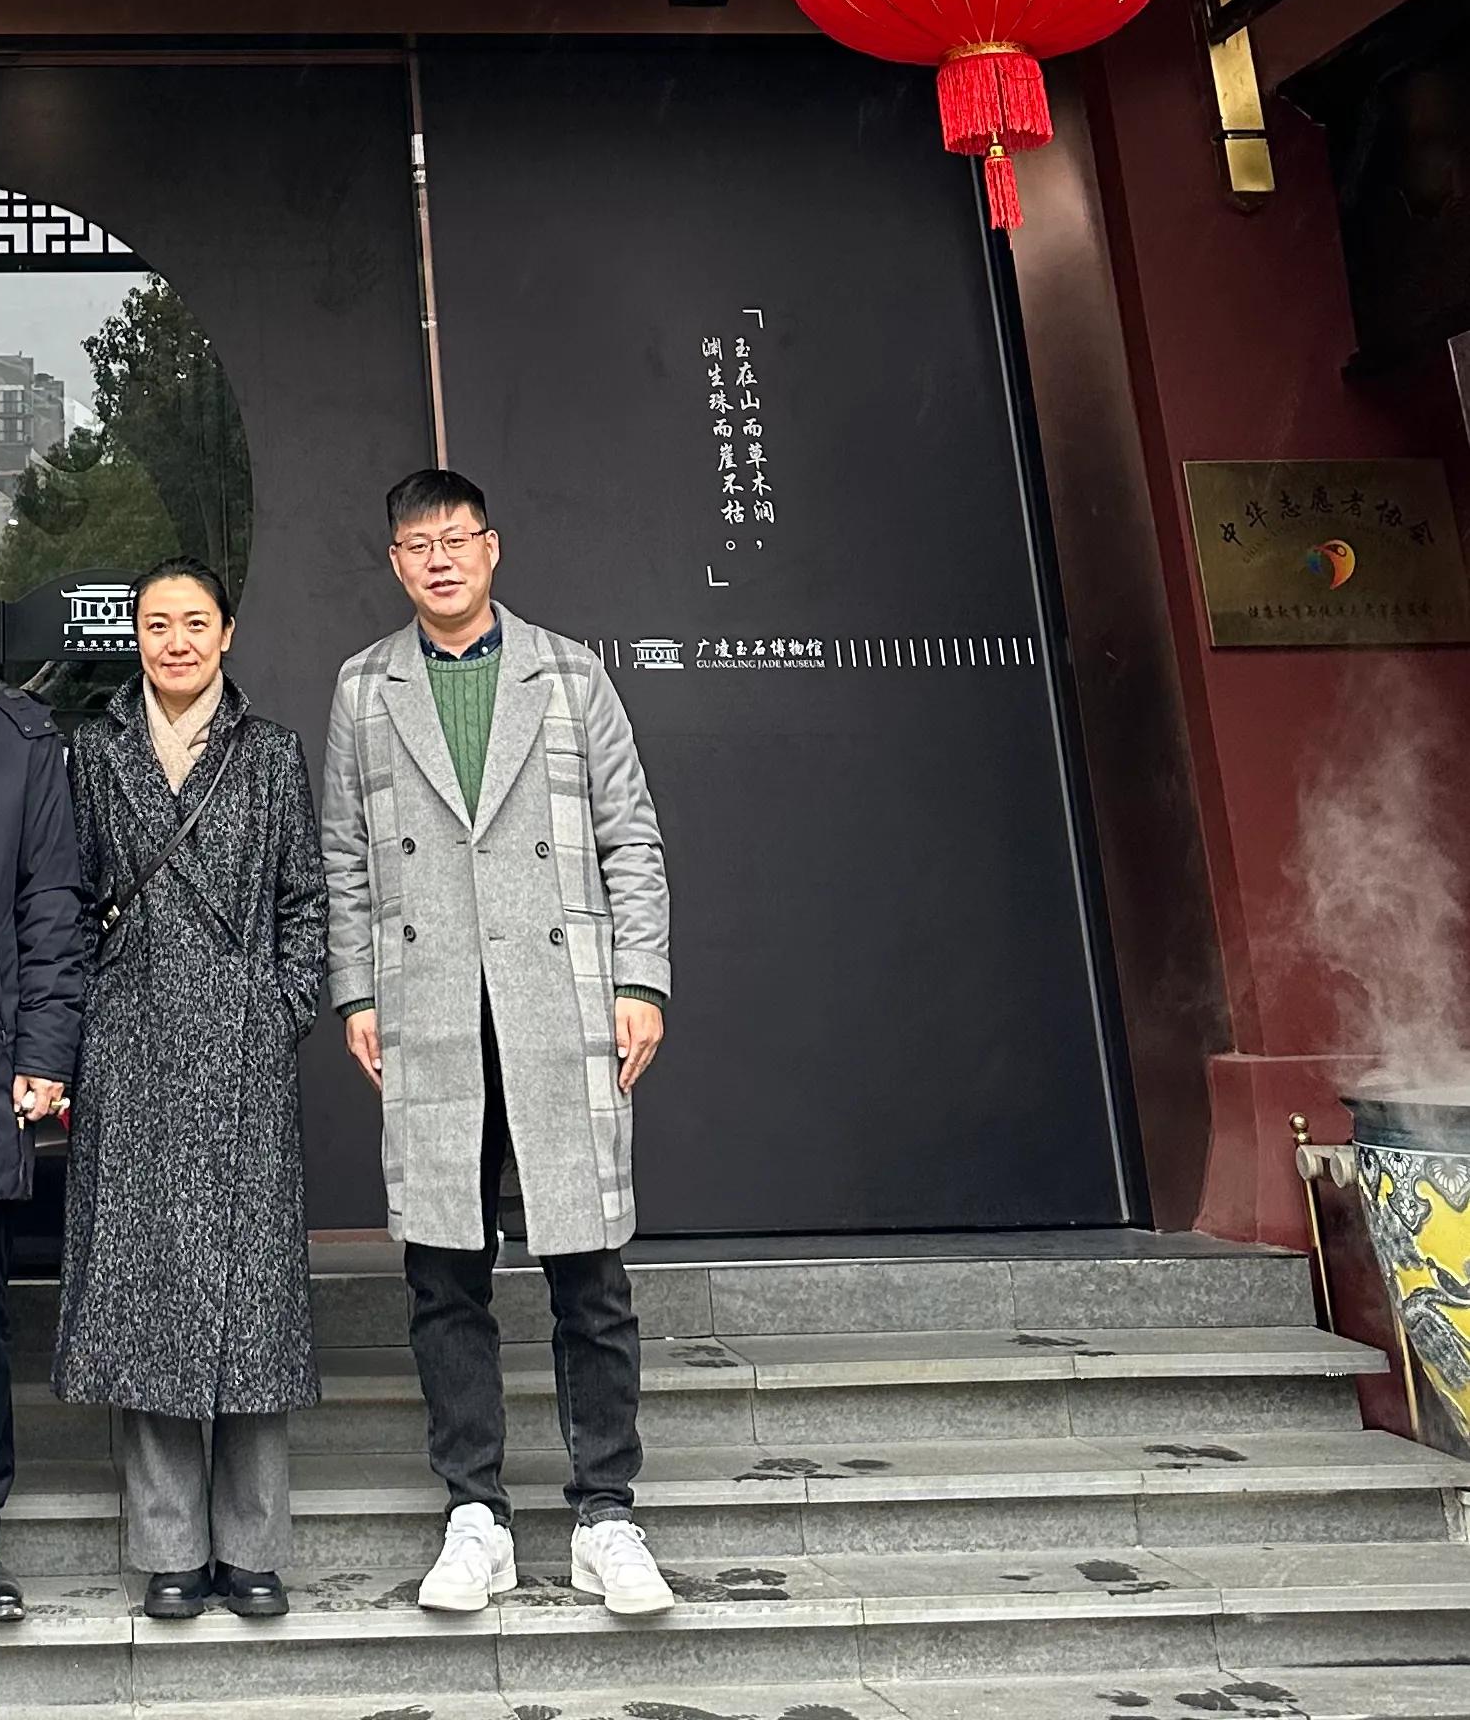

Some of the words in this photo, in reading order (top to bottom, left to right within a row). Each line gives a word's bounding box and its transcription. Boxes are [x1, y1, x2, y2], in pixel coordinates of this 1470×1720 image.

[696, 659, 757, 669] GUANGLING
[757, 659, 782, 670] JADE
[783, 659, 826, 669] MUSEUM
